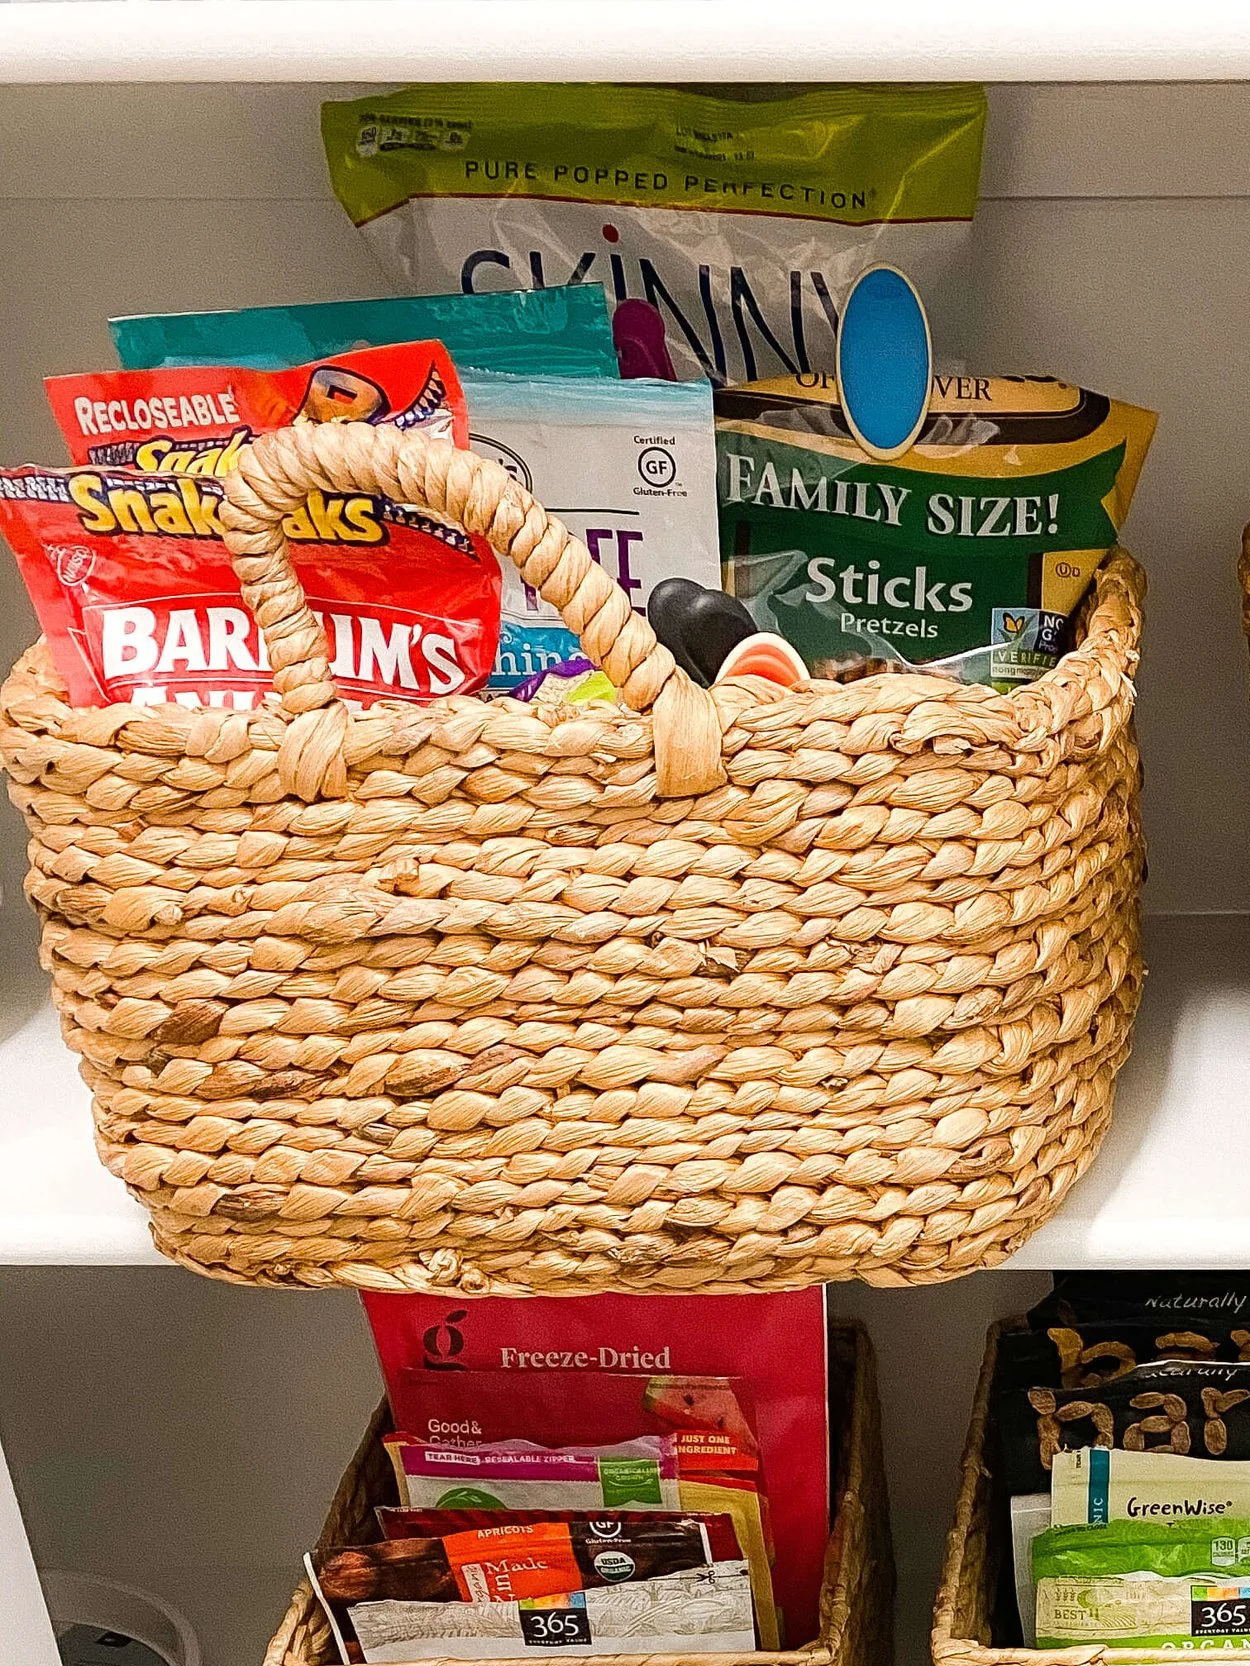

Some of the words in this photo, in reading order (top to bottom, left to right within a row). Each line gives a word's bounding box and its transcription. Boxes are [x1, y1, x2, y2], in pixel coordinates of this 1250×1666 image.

[465, 160, 538, 180] PURE
[553, 165, 669, 191] POPPED
[684, 173, 867, 209] PERFECTION
[74, 393, 240, 436] RECLOSEABLE
[633, 435, 676, 446] Certified
[646, 460, 668, 475] GF
[633, 486, 688, 498] Gluten-Free
[726, 454, 912, 527] FAMILY
[926, 494, 1059, 538] SIZE!
[805, 556, 974, 614] Sticks
[840, 611, 938, 639] Pretzels
[1000, 651, 1057, 667] VERIFIE
[1144, 1292, 1247, 1314] Naturally
[500, 1346, 671, 1370] Freeze-Dried
[681, 1434, 705, 1445] JUST
[708, 1435, 731, 1445] ONE
[1127, 1496, 1227, 1518] GreenWise
[476, 1525, 535, 1539] APRICOTS
[1213, 1540, 1233, 1551] 130
[485, 1557, 549, 1576] Made
[600, 1557, 627, 1566] USDA
[530, 1612, 579, 1637] 365
[1054, 1608, 1087, 1621] BEST
[1201, 1603, 1247, 1628] 365
